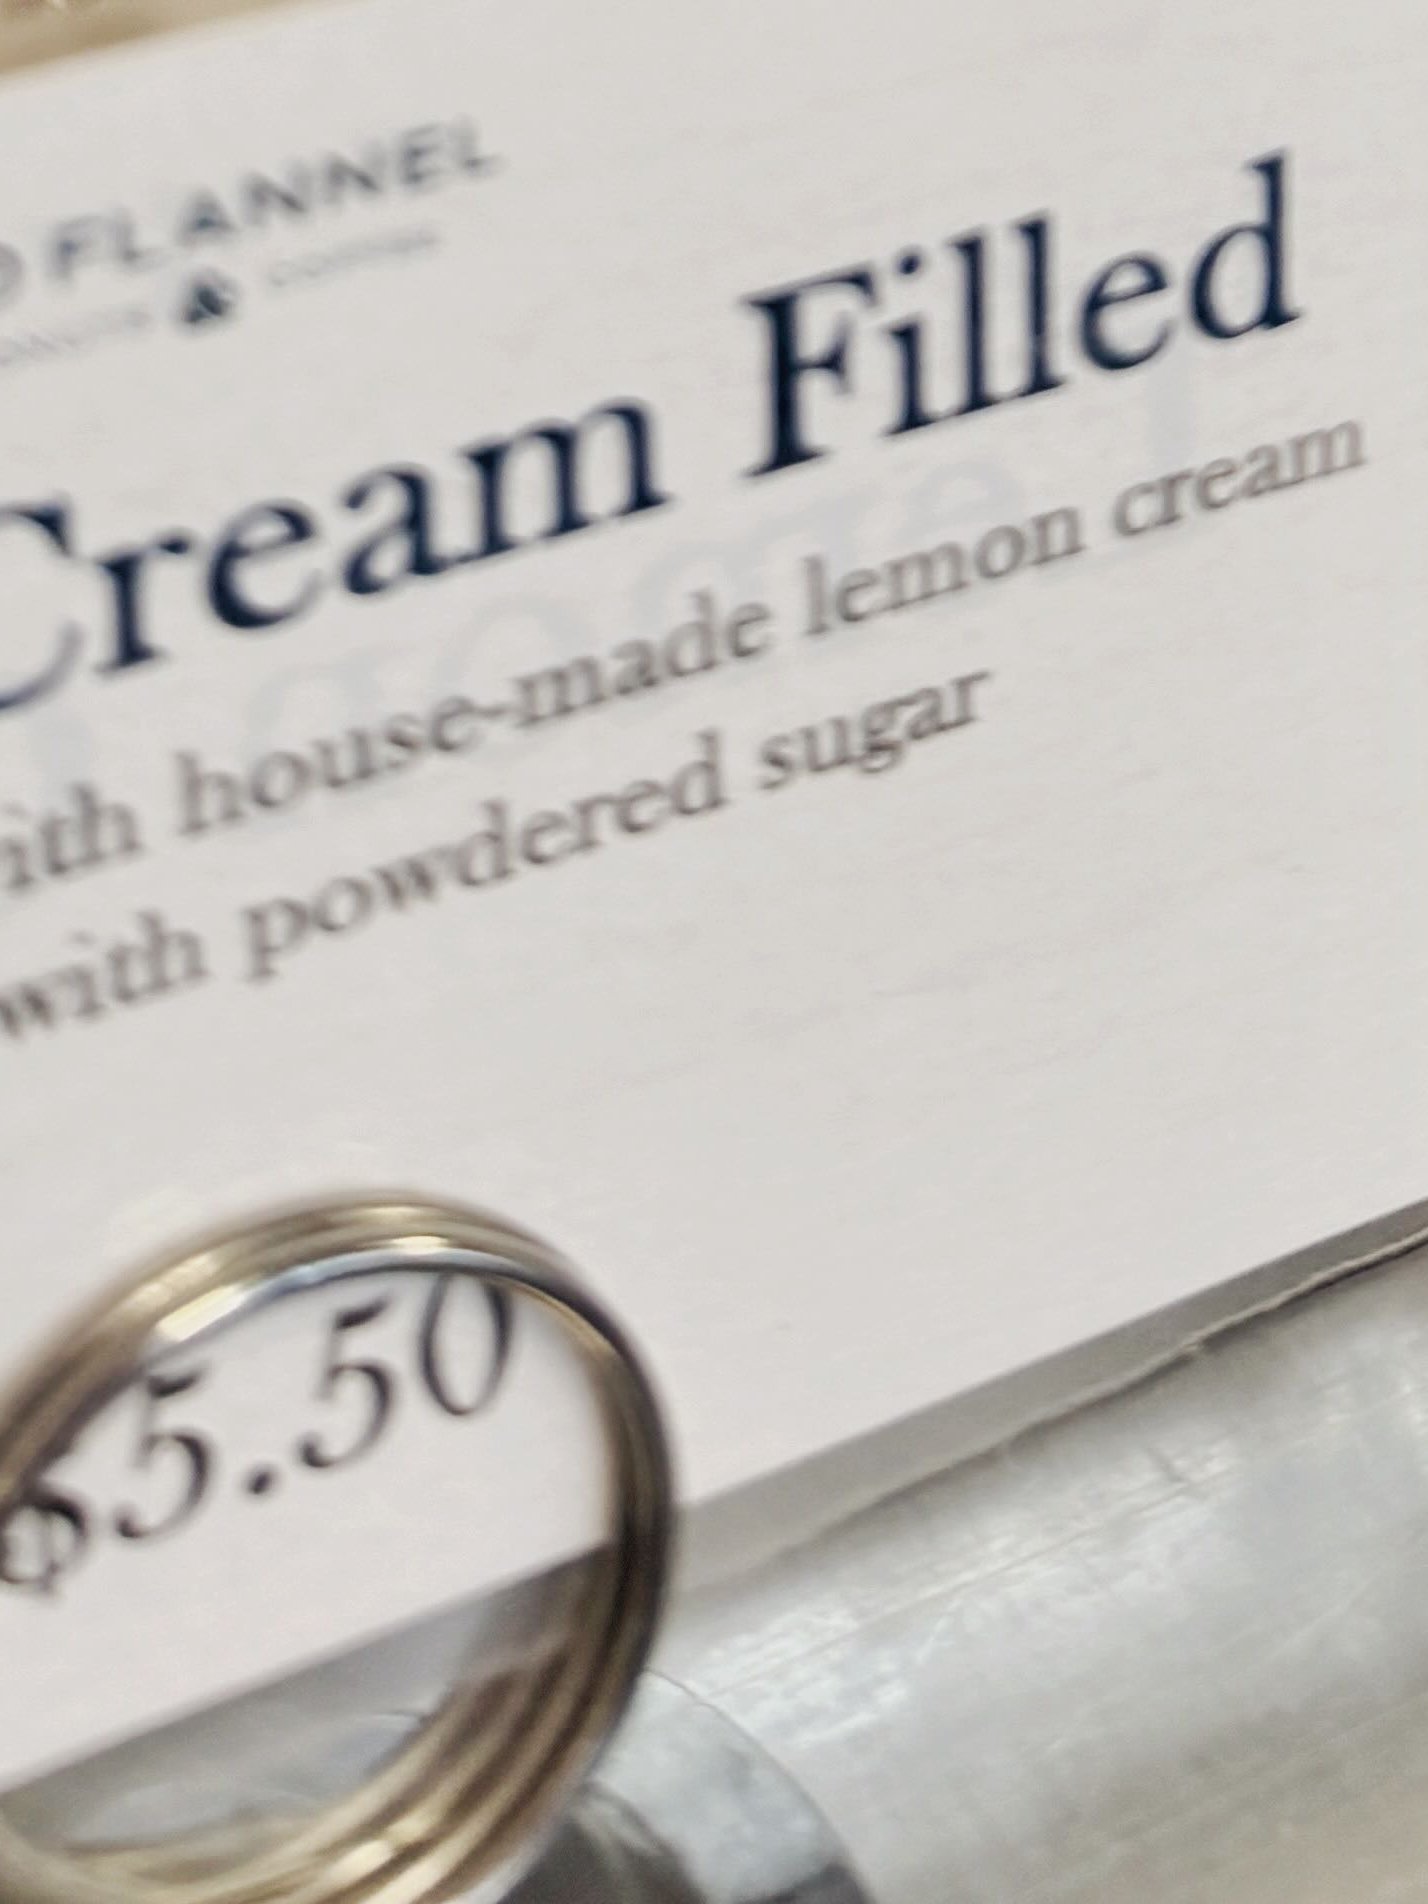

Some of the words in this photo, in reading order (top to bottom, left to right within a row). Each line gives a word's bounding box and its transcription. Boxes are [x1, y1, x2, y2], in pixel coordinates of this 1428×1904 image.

[45, 116, 507, 282] FLANNEL
[737, 145, 1305, 480] Filled
[177, 584, 772, 838] house-made
[801, 503, 1089, 637] lemon
[1110, 417, 1370, 539] cream
[241, 725, 732, 983] powdered
[753, 665, 994, 776] sugar
